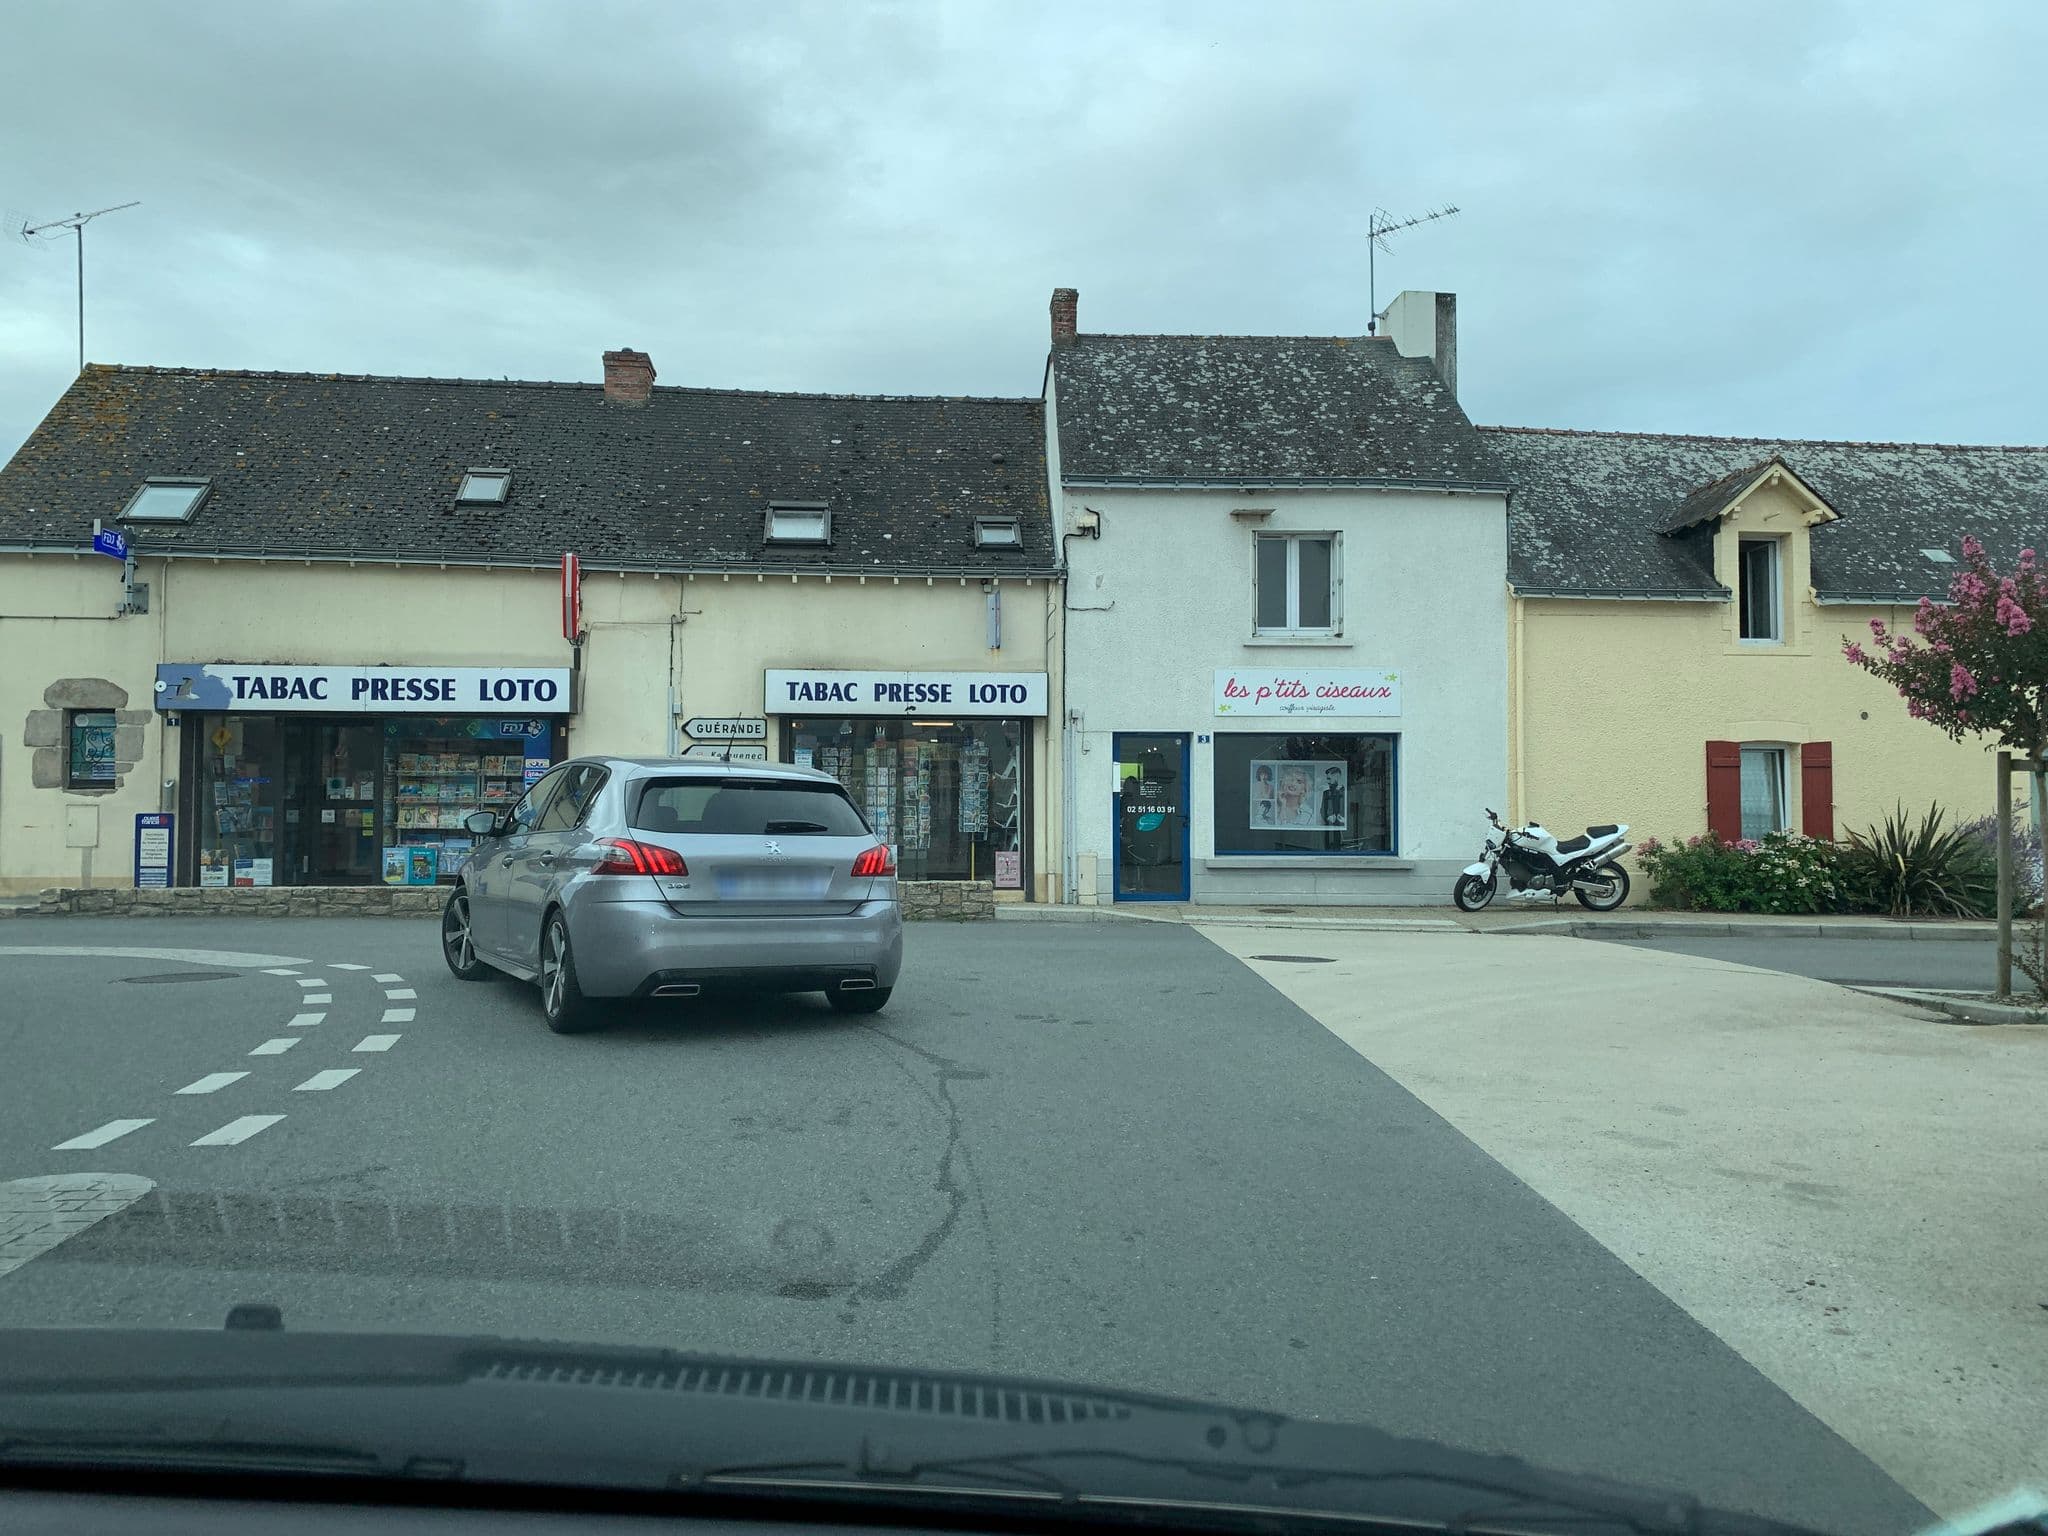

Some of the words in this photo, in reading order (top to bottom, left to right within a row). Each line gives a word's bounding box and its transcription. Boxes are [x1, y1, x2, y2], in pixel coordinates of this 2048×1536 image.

[103, 532, 115, 545] FDJ
[232, 676, 328, 701] TABAC
[351, 677, 456, 701] PRESSE
[479, 678, 558, 702] LOTO
[786, 681, 858, 702] TABAC
[873, 682, 952, 703] PRESSE
[969, 683, 1028, 704] LOTO
[1224, 677, 1250, 698] les
[1255, 677, 1310, 706] p'tits
[1315, 681, 1392, 698] ciseaux
[502, 723, 524, 732] FDJ
[696, 721, 761, 734] GUÉRANDE
[1138, 805, 1146, 813] 51
[1147, 805, 1156, 813] 16
